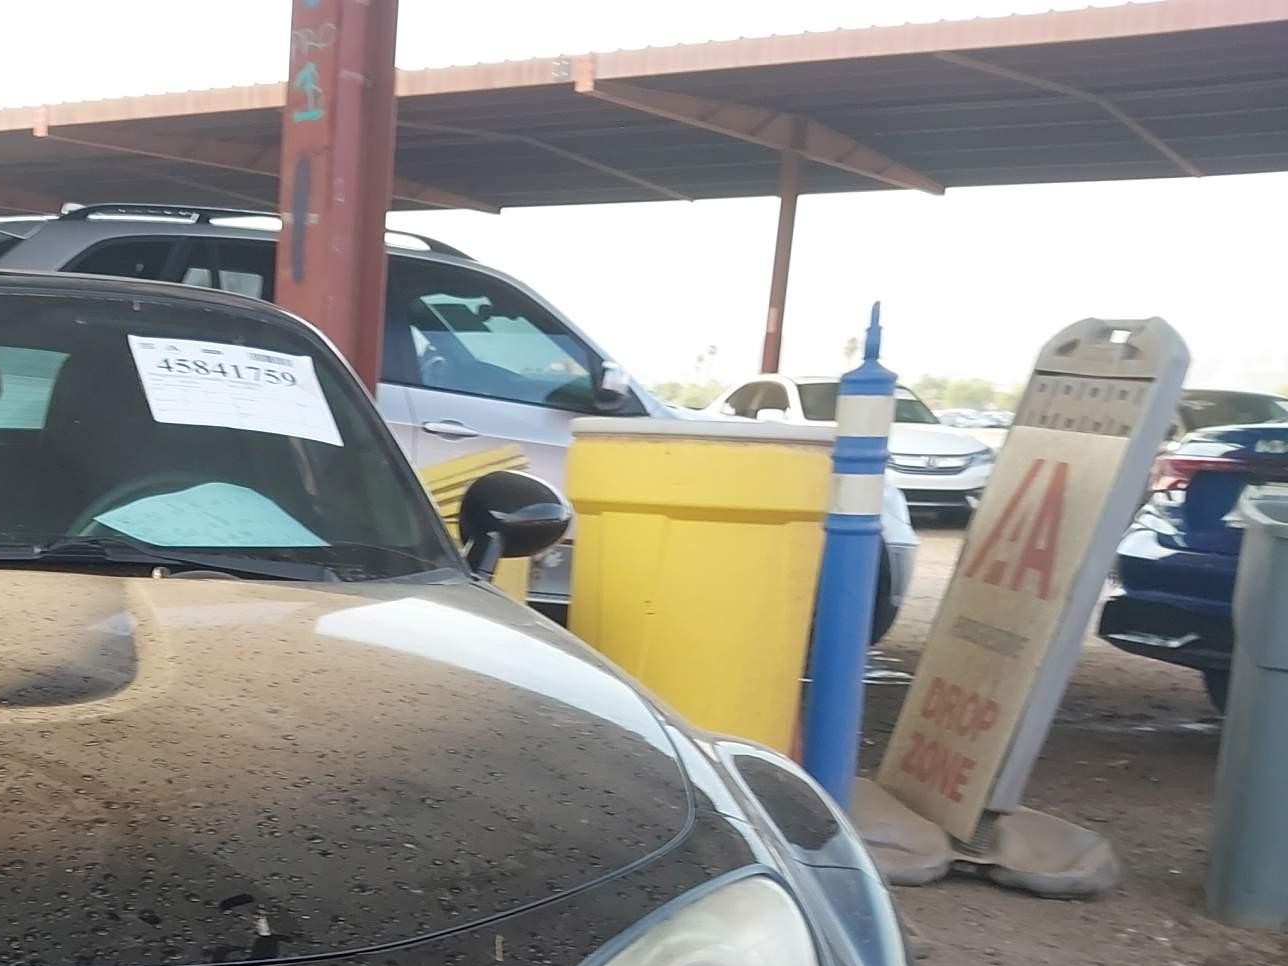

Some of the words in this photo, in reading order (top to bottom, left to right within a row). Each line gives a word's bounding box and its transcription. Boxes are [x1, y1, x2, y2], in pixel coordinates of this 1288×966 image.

[157, 357, 298, 388] 45841759
[921, 676, 1000, 737] DROP
[900, 731, 977, 803] ZONE
